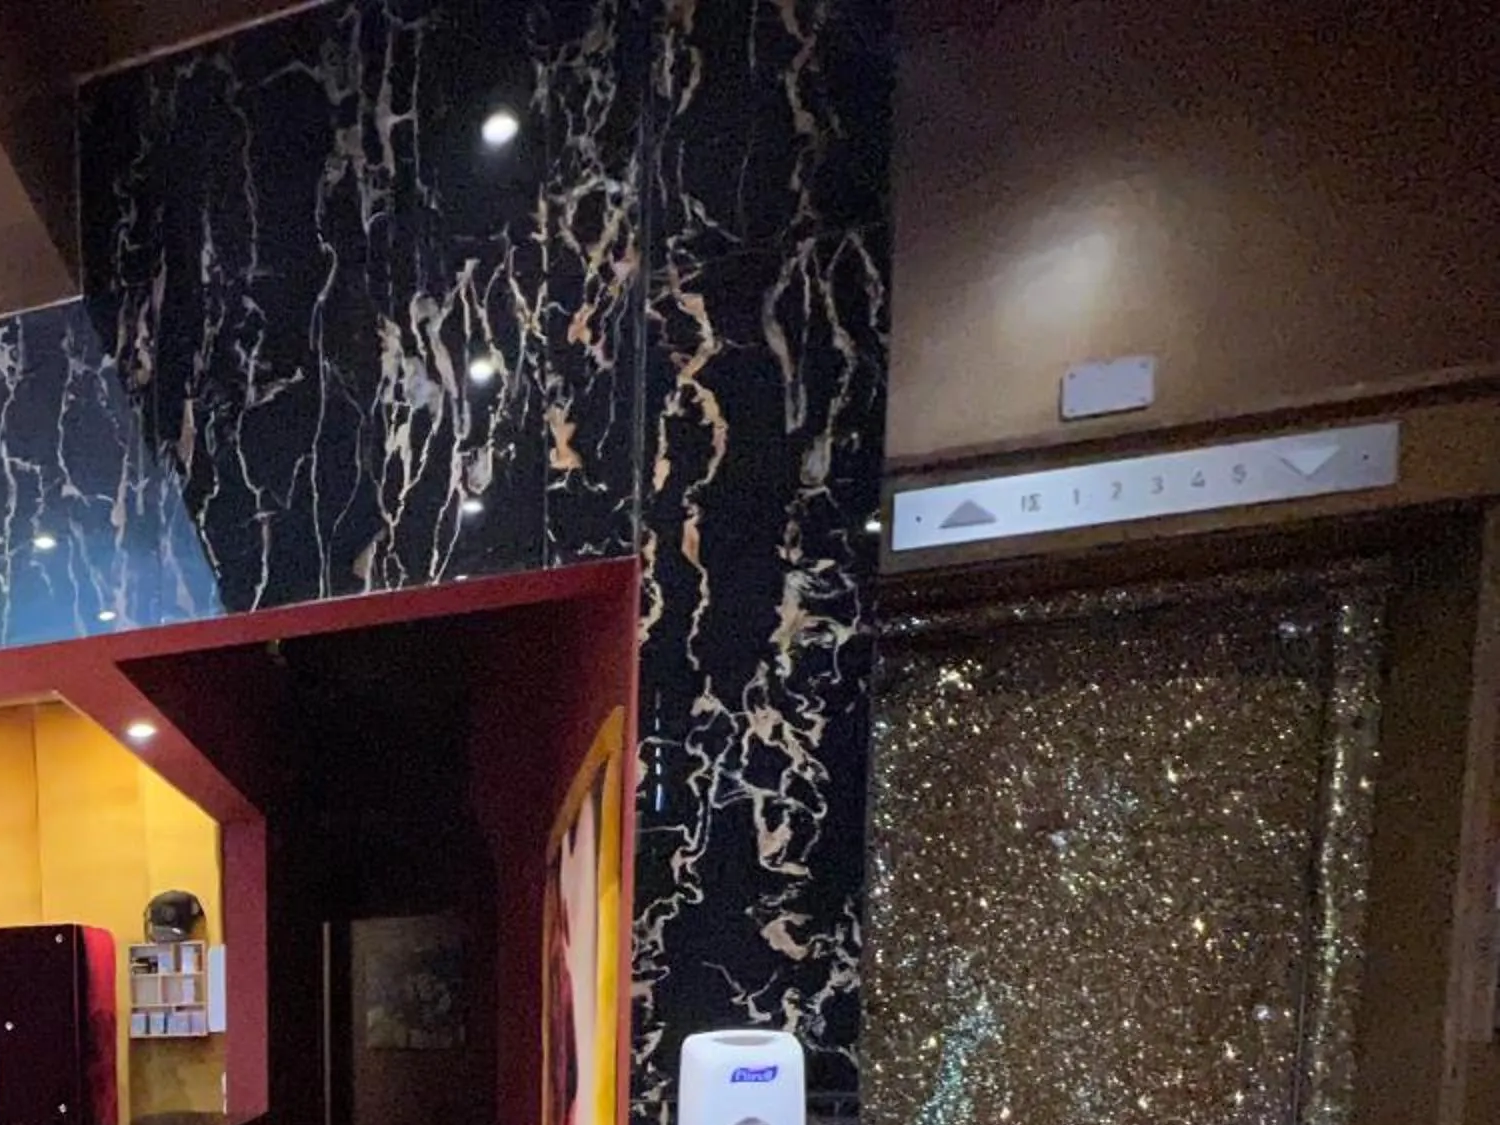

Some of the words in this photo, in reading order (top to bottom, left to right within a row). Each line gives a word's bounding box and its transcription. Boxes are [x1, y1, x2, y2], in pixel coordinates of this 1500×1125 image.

[1072, 488, 1080, 505] 1
[1110, 481, 1123, 500] 2
[1151, 475, 1165, 494] 3
[1190, 467, 1206, 487] 4
[1231, 463, 1247, 485] 5
